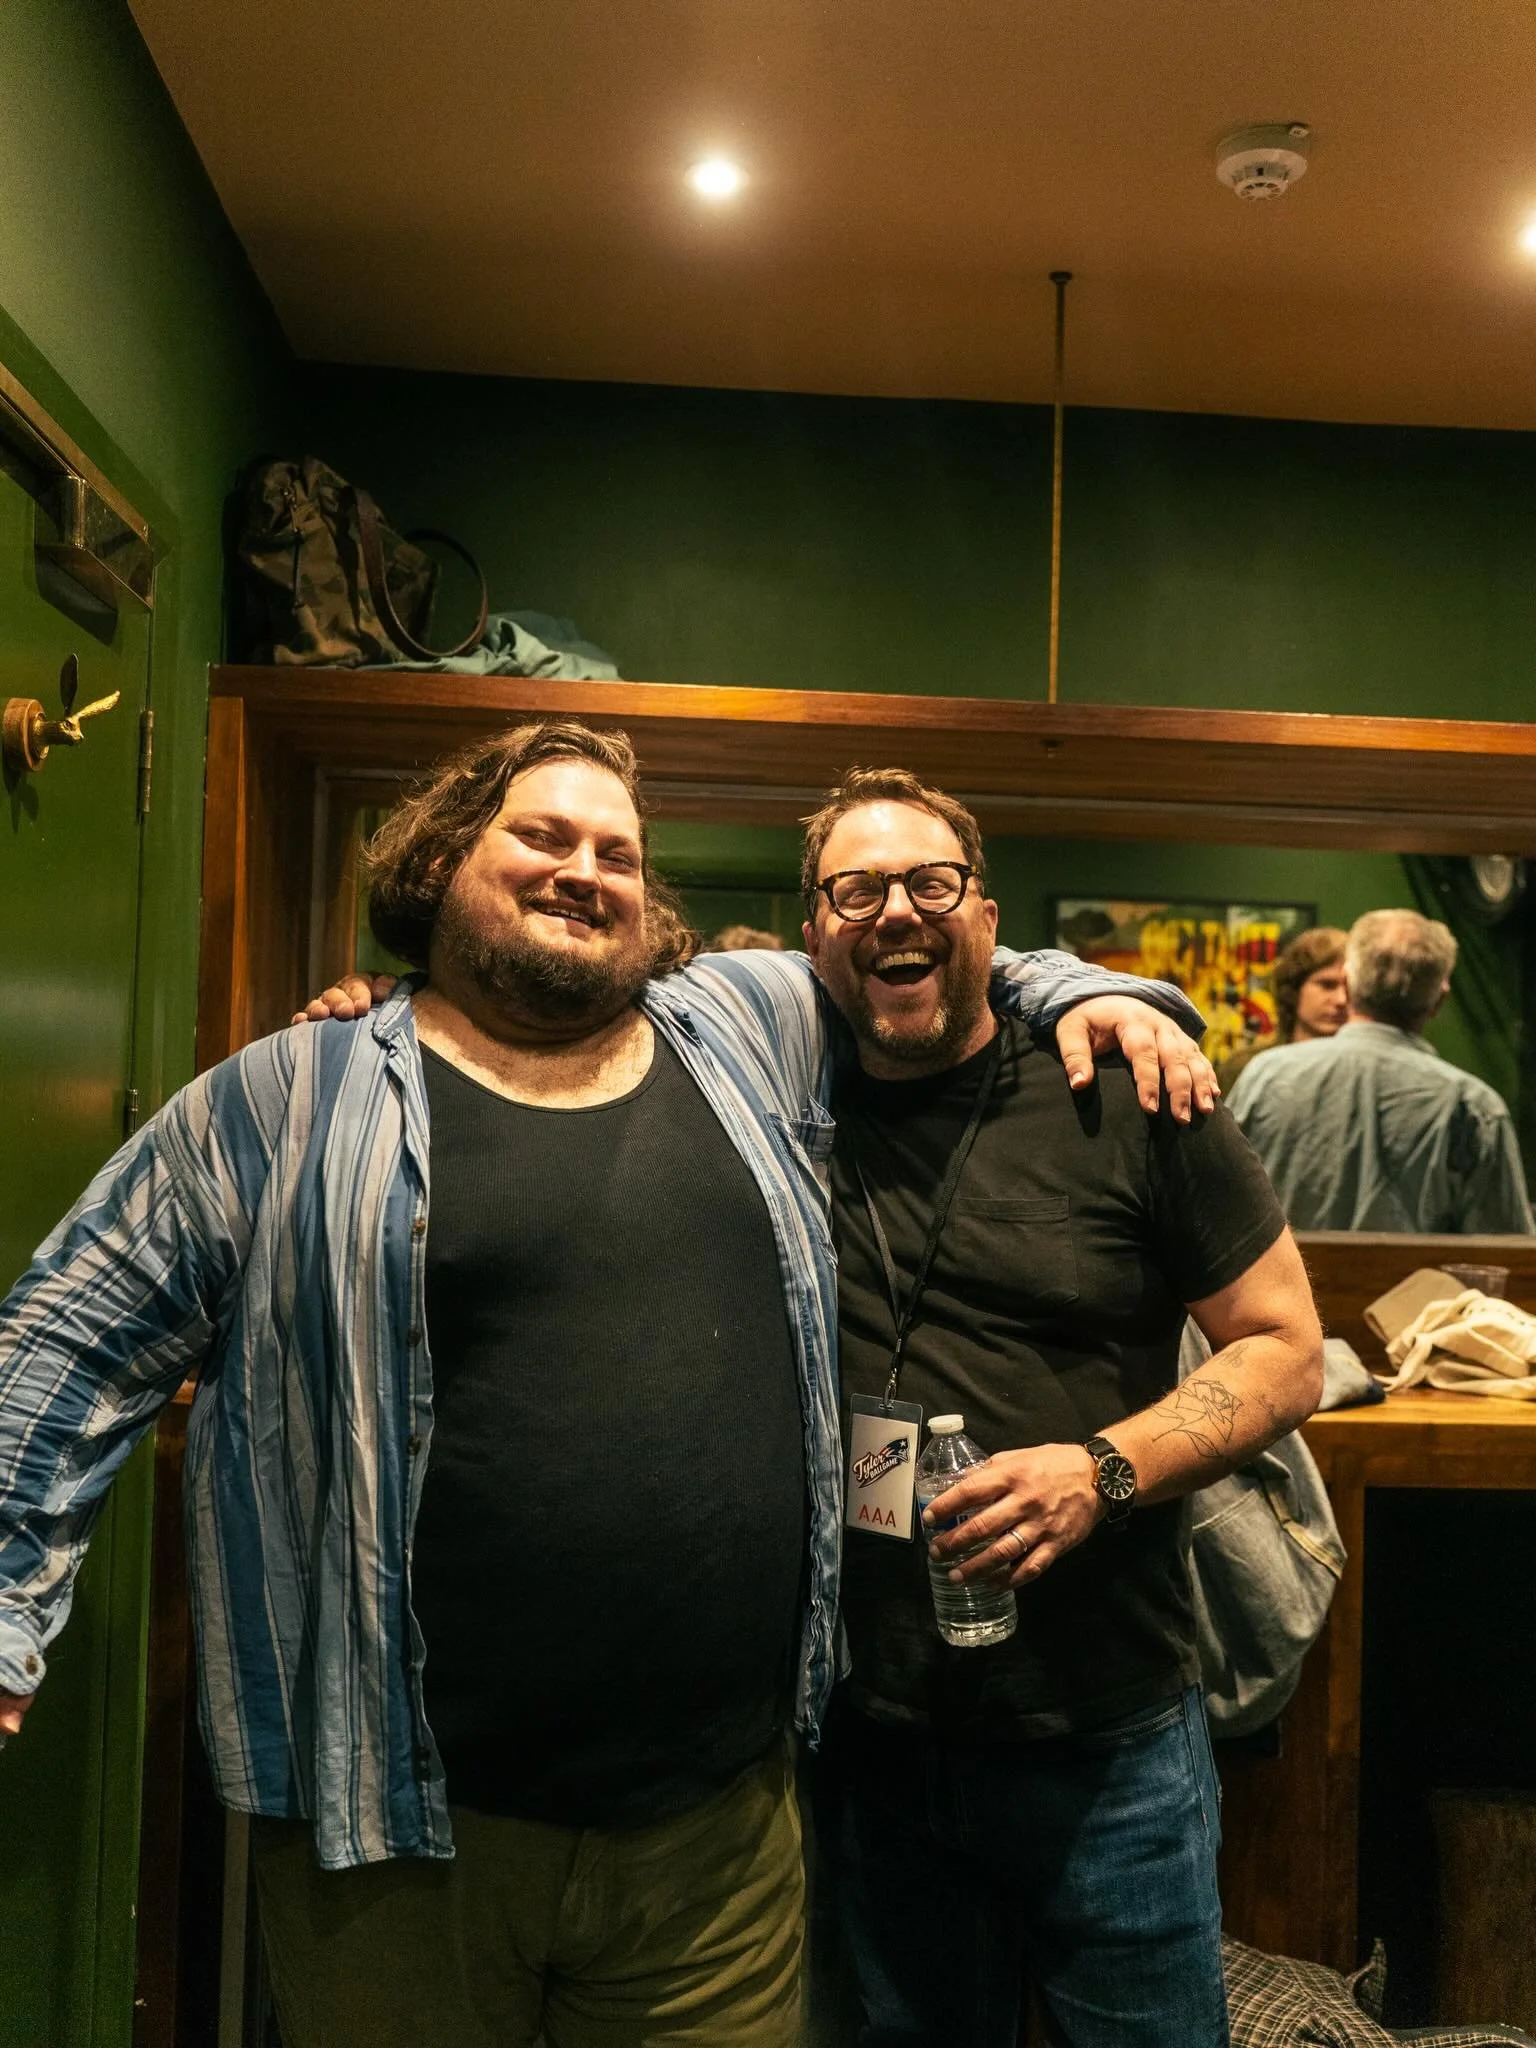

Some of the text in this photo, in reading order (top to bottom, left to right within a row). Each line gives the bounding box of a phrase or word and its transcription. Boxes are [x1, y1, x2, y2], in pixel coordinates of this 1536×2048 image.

[853, 1453, 884, 1480] Tyler
[870, 1457, 898, 1479] BALLGAME
[858, 1503, 896, 1528] AAA
